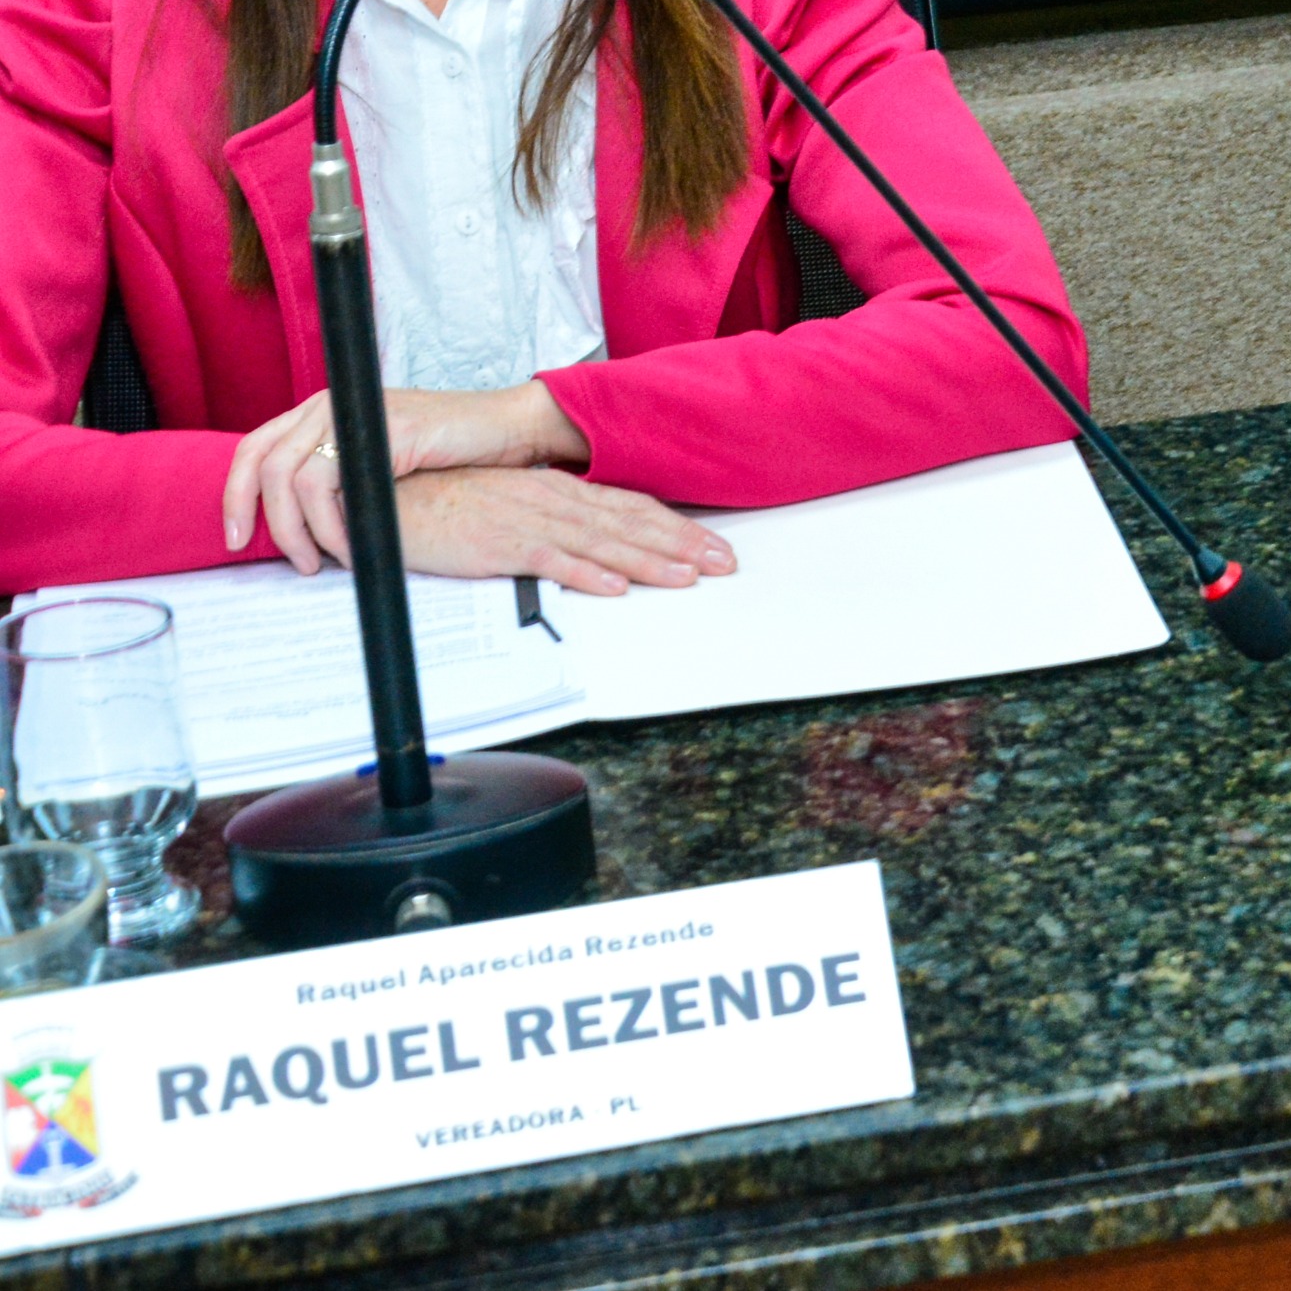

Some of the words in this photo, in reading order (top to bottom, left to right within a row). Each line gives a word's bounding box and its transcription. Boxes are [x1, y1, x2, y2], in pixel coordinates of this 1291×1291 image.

[296, 969, 406, 1005] Raquel
[418, 944, 574, 986] Aparecida
[584, 921, 714, 957] Rezende
[157, 1021, 481, 1122] RAQUEL
[505, 952, 867, 1062] REZENDE
[416, 1105, 584, 1149] VEREADORA
[609, 1096, 639, 1115] PL
